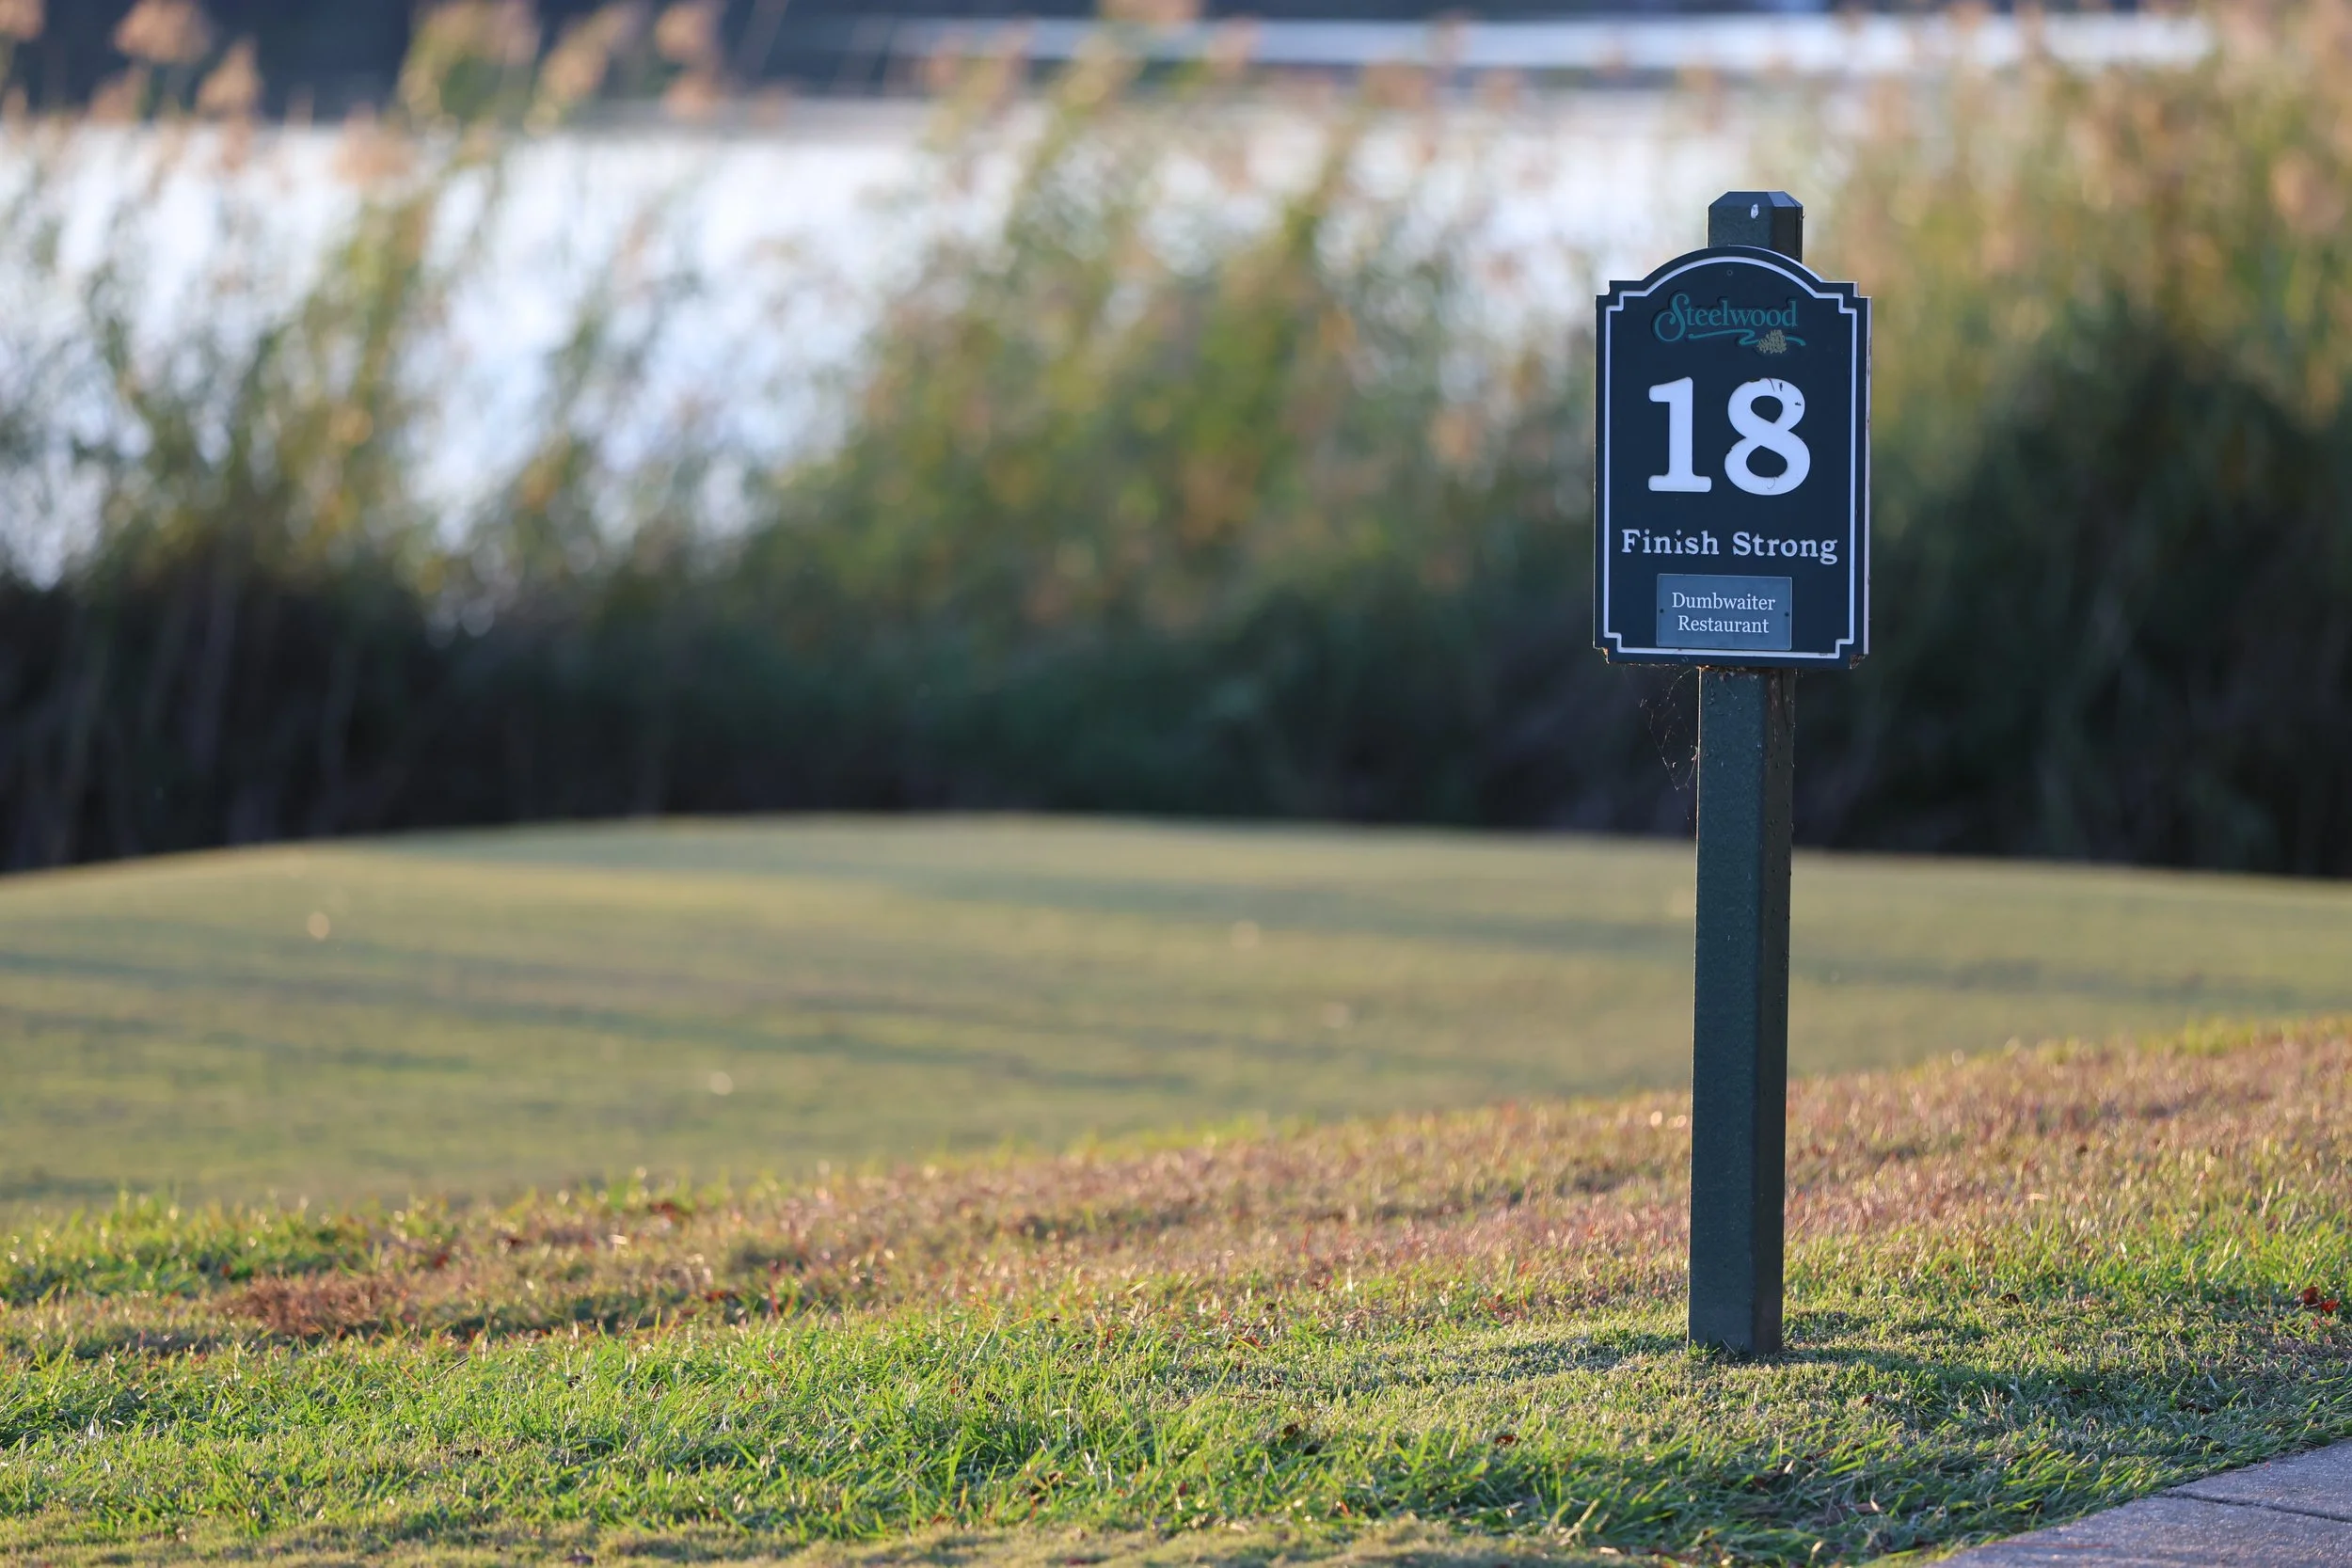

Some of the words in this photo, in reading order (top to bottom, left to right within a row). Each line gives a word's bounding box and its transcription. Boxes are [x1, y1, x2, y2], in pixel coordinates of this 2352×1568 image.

[1654, 293, 1798, 341] Steelwood
[1648, 376, 1810, 496] 18
[1621, 529, 1719, 555] Finish
[1732, 531, 1838, 564] Strong
[1672, 592, 1775, 610] Dumbwaiter
[1677, 615, 1769, 633] Restaurant
